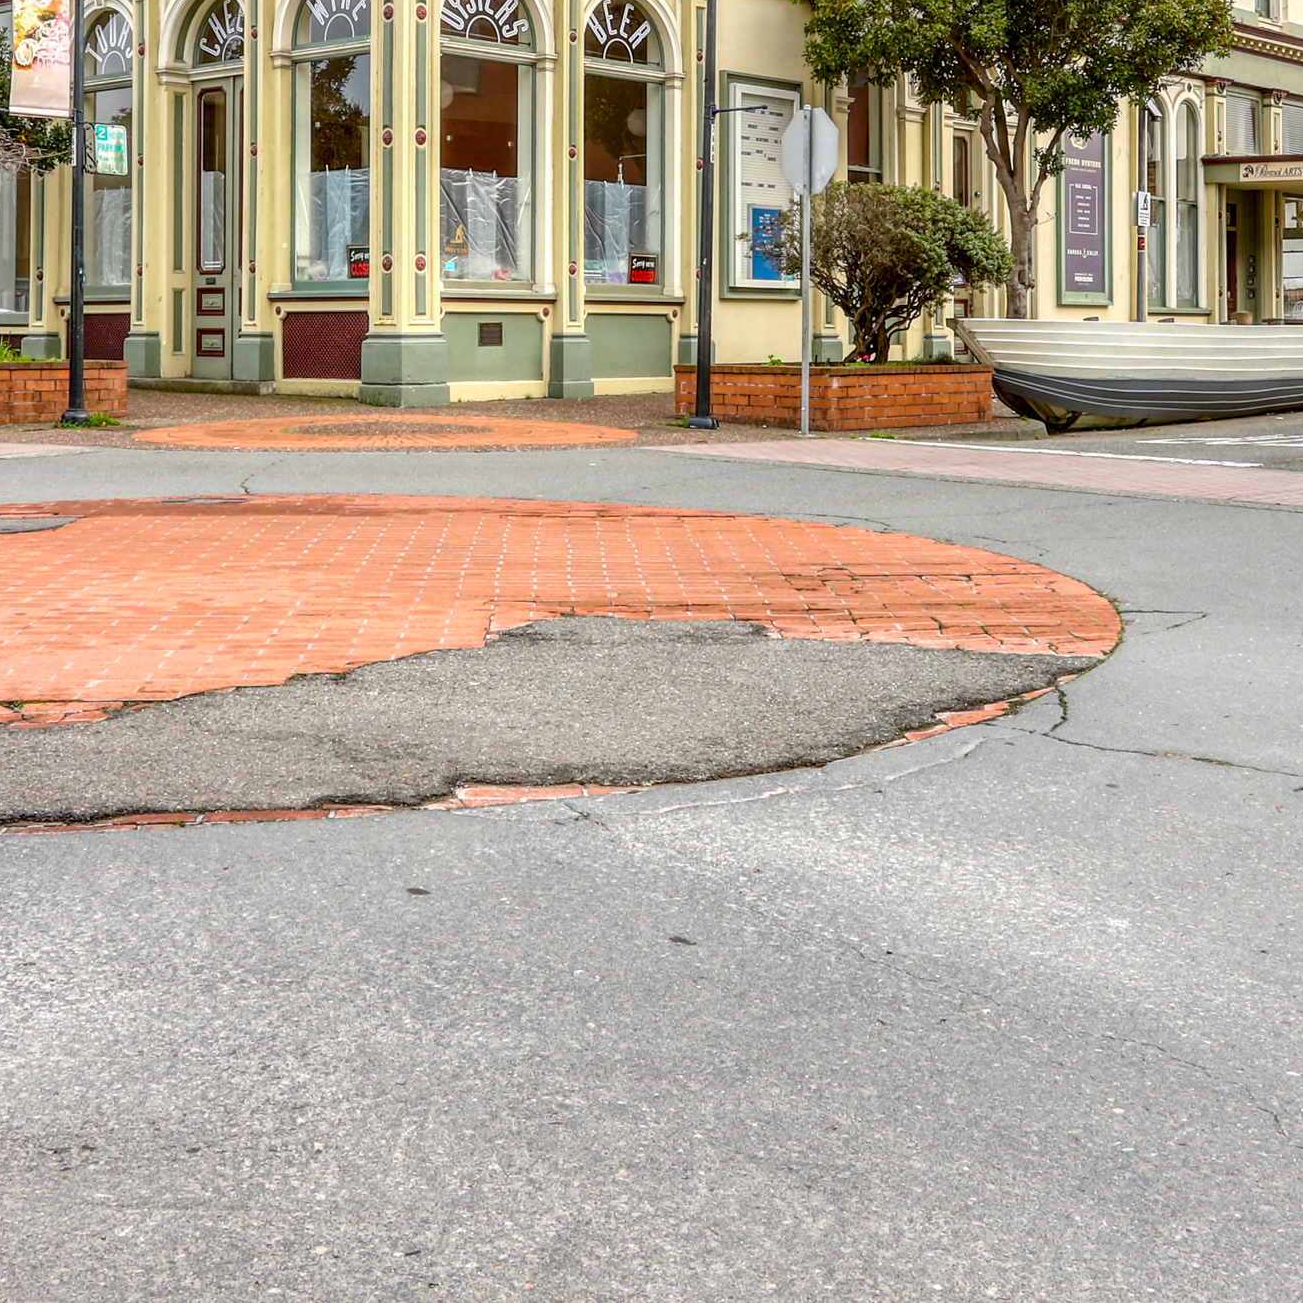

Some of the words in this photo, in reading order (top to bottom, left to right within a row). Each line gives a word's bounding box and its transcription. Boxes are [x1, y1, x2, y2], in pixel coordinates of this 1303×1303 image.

[587, 0, 652, 50] BEER
[98, 127, 106, 138] 2
[1066, 157, 1080, 166] FRESH
[1081, 159, 1101, 168] OYSTERS
[1283, 167, 1303, 176] ARTS
[631, 269, 655, 282] CLOSED
